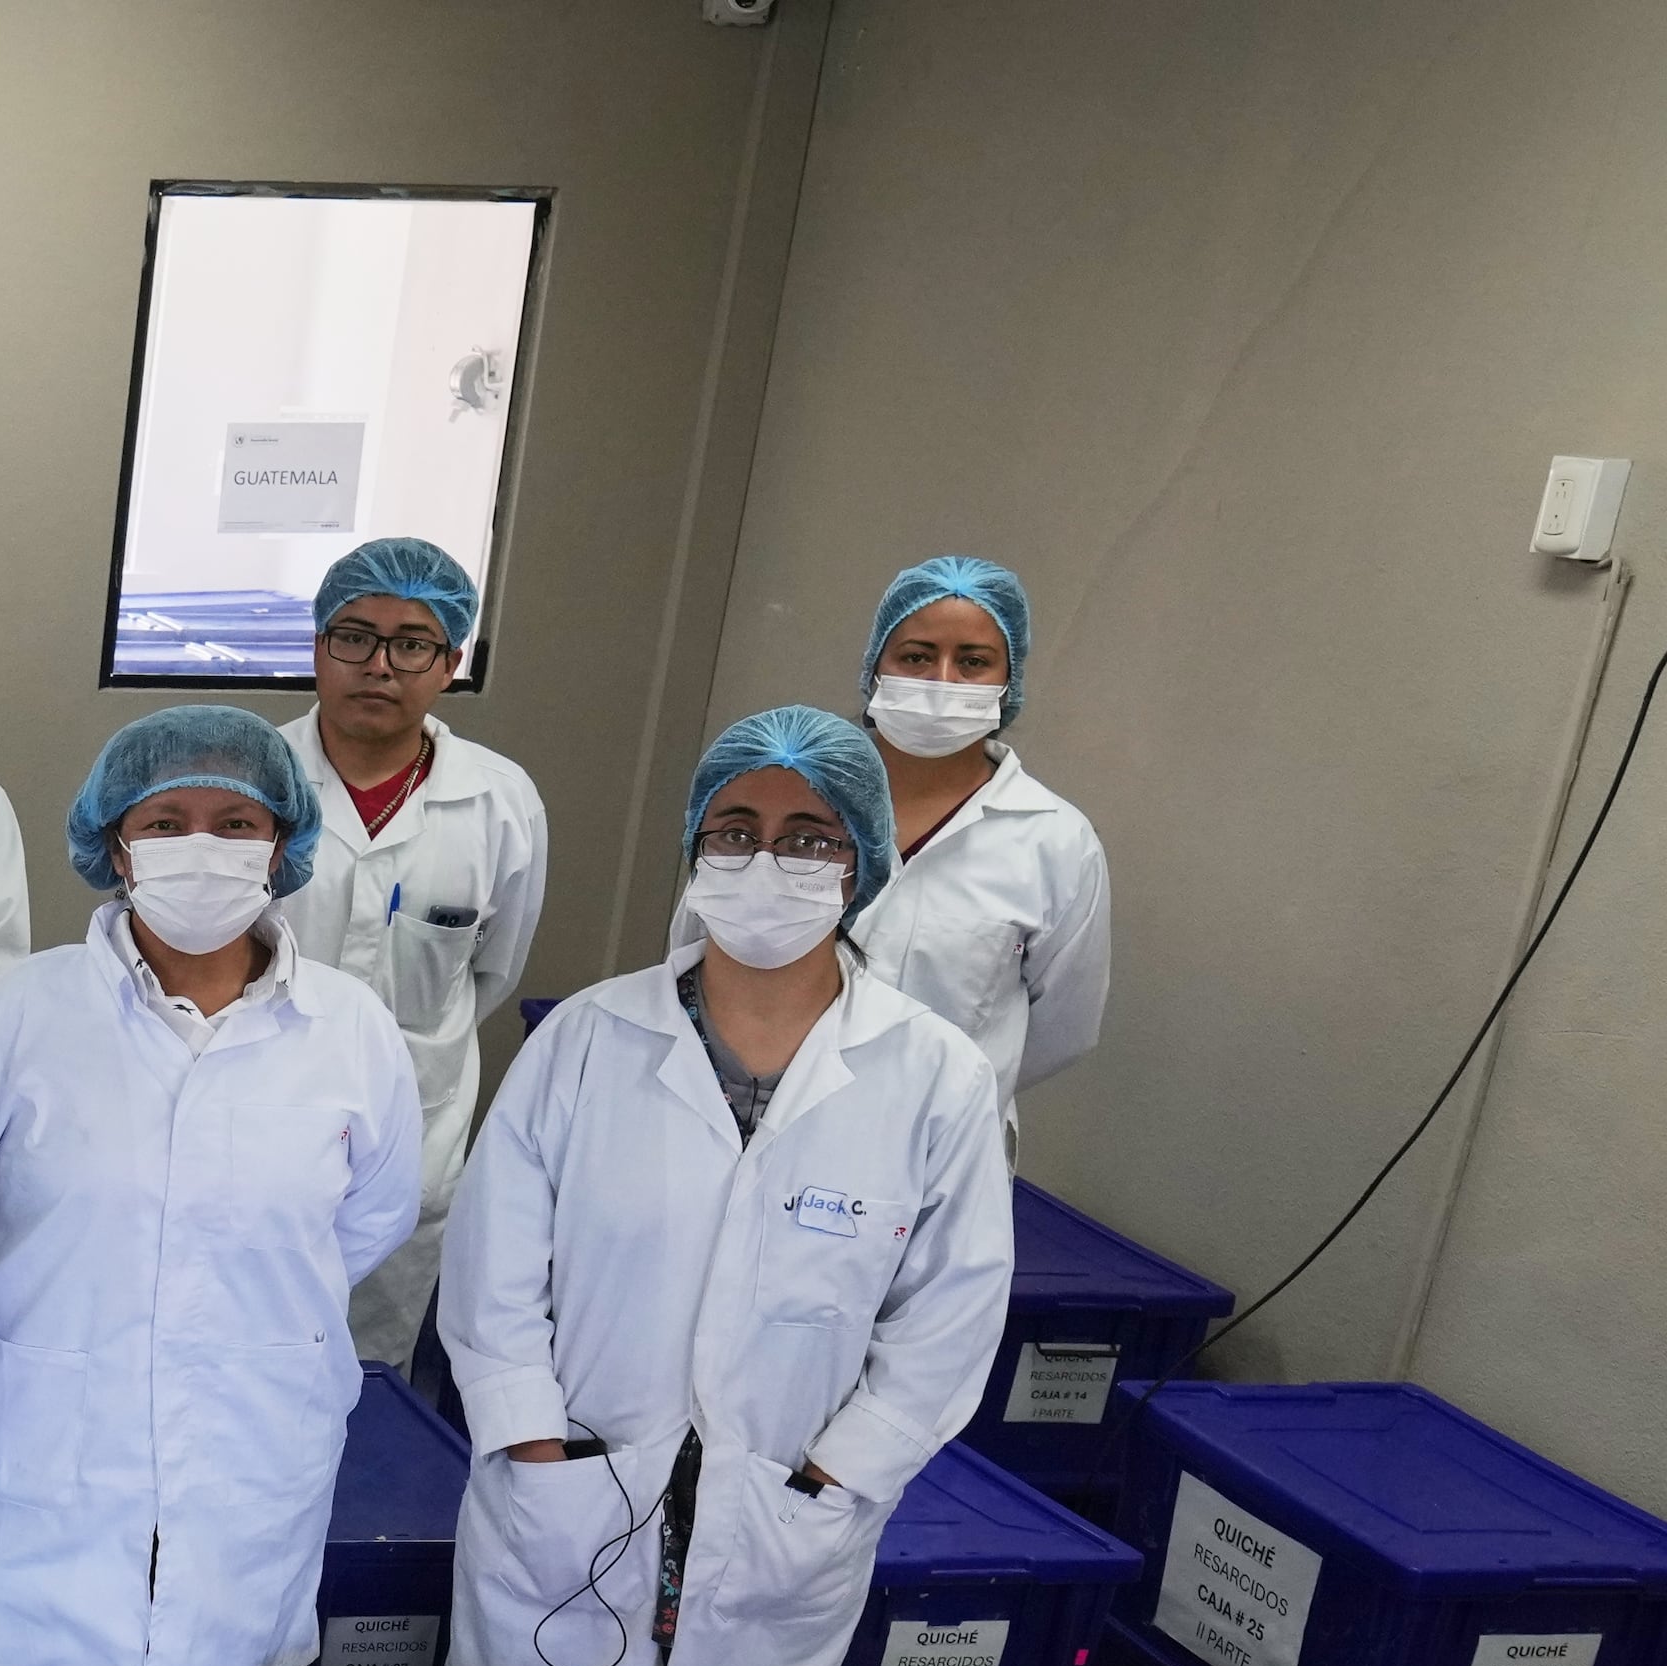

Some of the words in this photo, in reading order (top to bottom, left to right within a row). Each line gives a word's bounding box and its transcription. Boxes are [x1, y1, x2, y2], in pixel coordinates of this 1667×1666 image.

[234, 470, 338, 486] GUATEMALA
[804, 1194, 847, 1215] Jack
[1030, 1370, 1107, 1382] RESARCIDOS
[1031, 1390, 1061, 1400] CAJA
[1214, 1517, 1277, 1569] QUICHÉ
[1194, 1543, 1289, 1617] RESARCIDOS
[1198, 1583, 1232, 1620] CAJA
[1234, 1610, 1245, 1627] #
[1247, 1614, 1265, 1641] 25
[355, 1619, 411, 1633] QUICHÉ
[1196, 1621, 1205, 1639] II
[917, 1629, 979, 1645] QUICHÉ
[341, 1640, 427, 1654] RESARCIDOS
[1506, 1644, 1568, 1659] QUICHÉ
